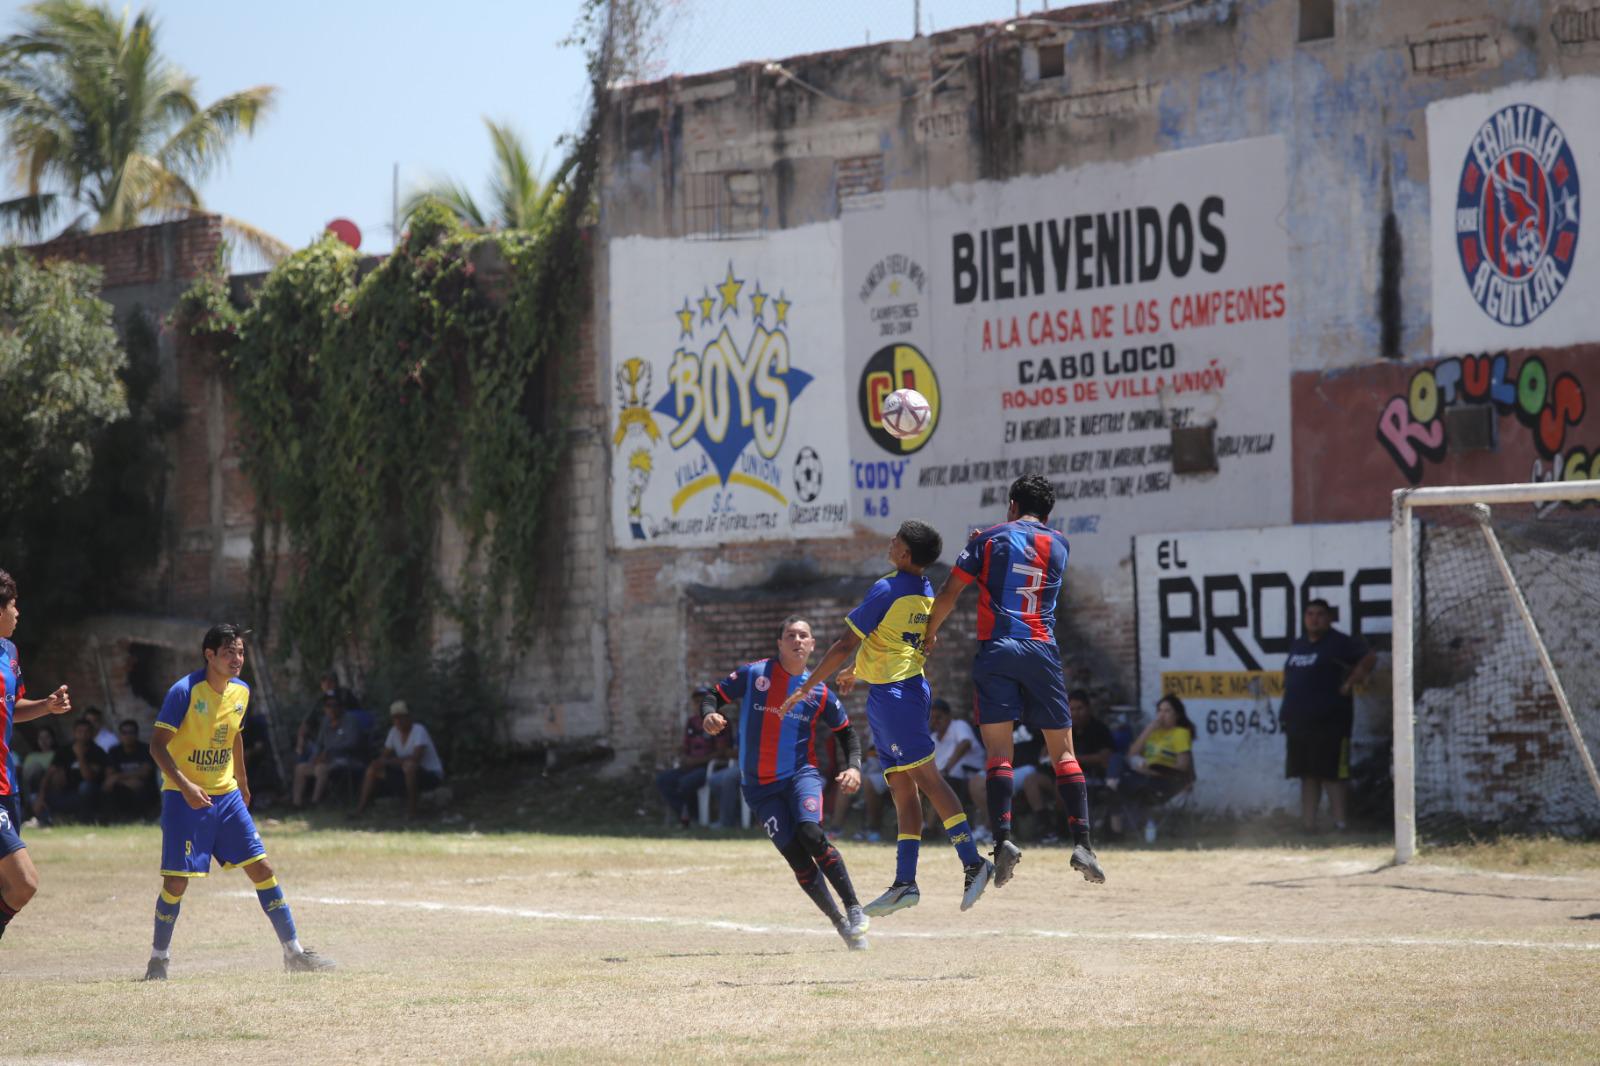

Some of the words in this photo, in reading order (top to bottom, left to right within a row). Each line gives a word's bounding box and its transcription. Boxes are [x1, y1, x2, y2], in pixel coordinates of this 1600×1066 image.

[1472, 105, 1563, 174] FAMILIA
[952, 195, 1227, 304] BIENVENIDOS
[1472, 254, 1566, 326] AGUILAR
[982, 320, 993, 351] A
[998, 317, 1021, 349] LA
[1028, 308, 1085, 345] CASA
[1091, 304, 1115, 339] DE
[1123, 298, 1160, 336] LOS
[1170, 283, 1286, 330] CAMPEONES
[1002, 386, 1068, 410] ROJOS
[1074, 382, 1099, 401] DE
[1104, 378, 1166, 400] VILLA
[1173, 359, 1227, 394] UNIÓN
[1018, 352, 1095, 385] CABO
[1103, 343, 1176, 375] LOCO
[668, 324, 790, 460] BOYS
[1004, 422, 1017, 443] EN
[1065, 415, 1077, 438] DE
[1376, 352, 1586, 486] ROTULOS
[674, 454, 710, 488] VILLA
[879, 496, 890, 517] 8
[1157, 539, 1187, 570] EL
[1158, 567, 1393, 672] PROFE
[1210, 674, 1223, 695] DE
[764, 815, 779, 838] 27
